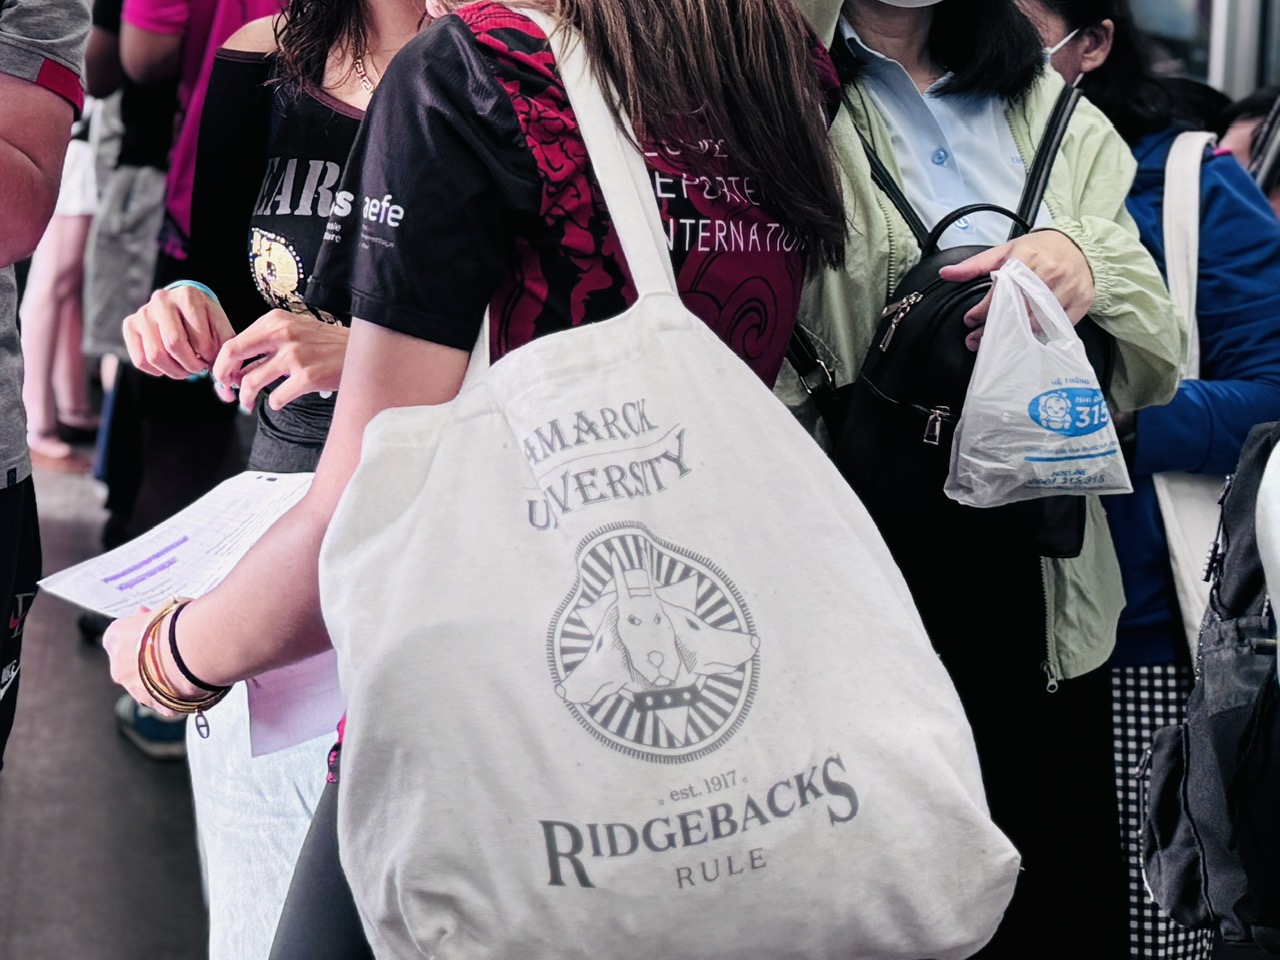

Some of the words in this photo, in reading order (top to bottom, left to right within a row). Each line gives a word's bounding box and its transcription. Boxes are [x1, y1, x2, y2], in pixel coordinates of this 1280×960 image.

[1075, 400, 1110, 428] 315
[669, 781, 702, 804] est.
[704, 770, 738, 796] 1917
[539, 755, 859, 888] RIDGEBACKS
[675, 847, 768, 889] RULE
